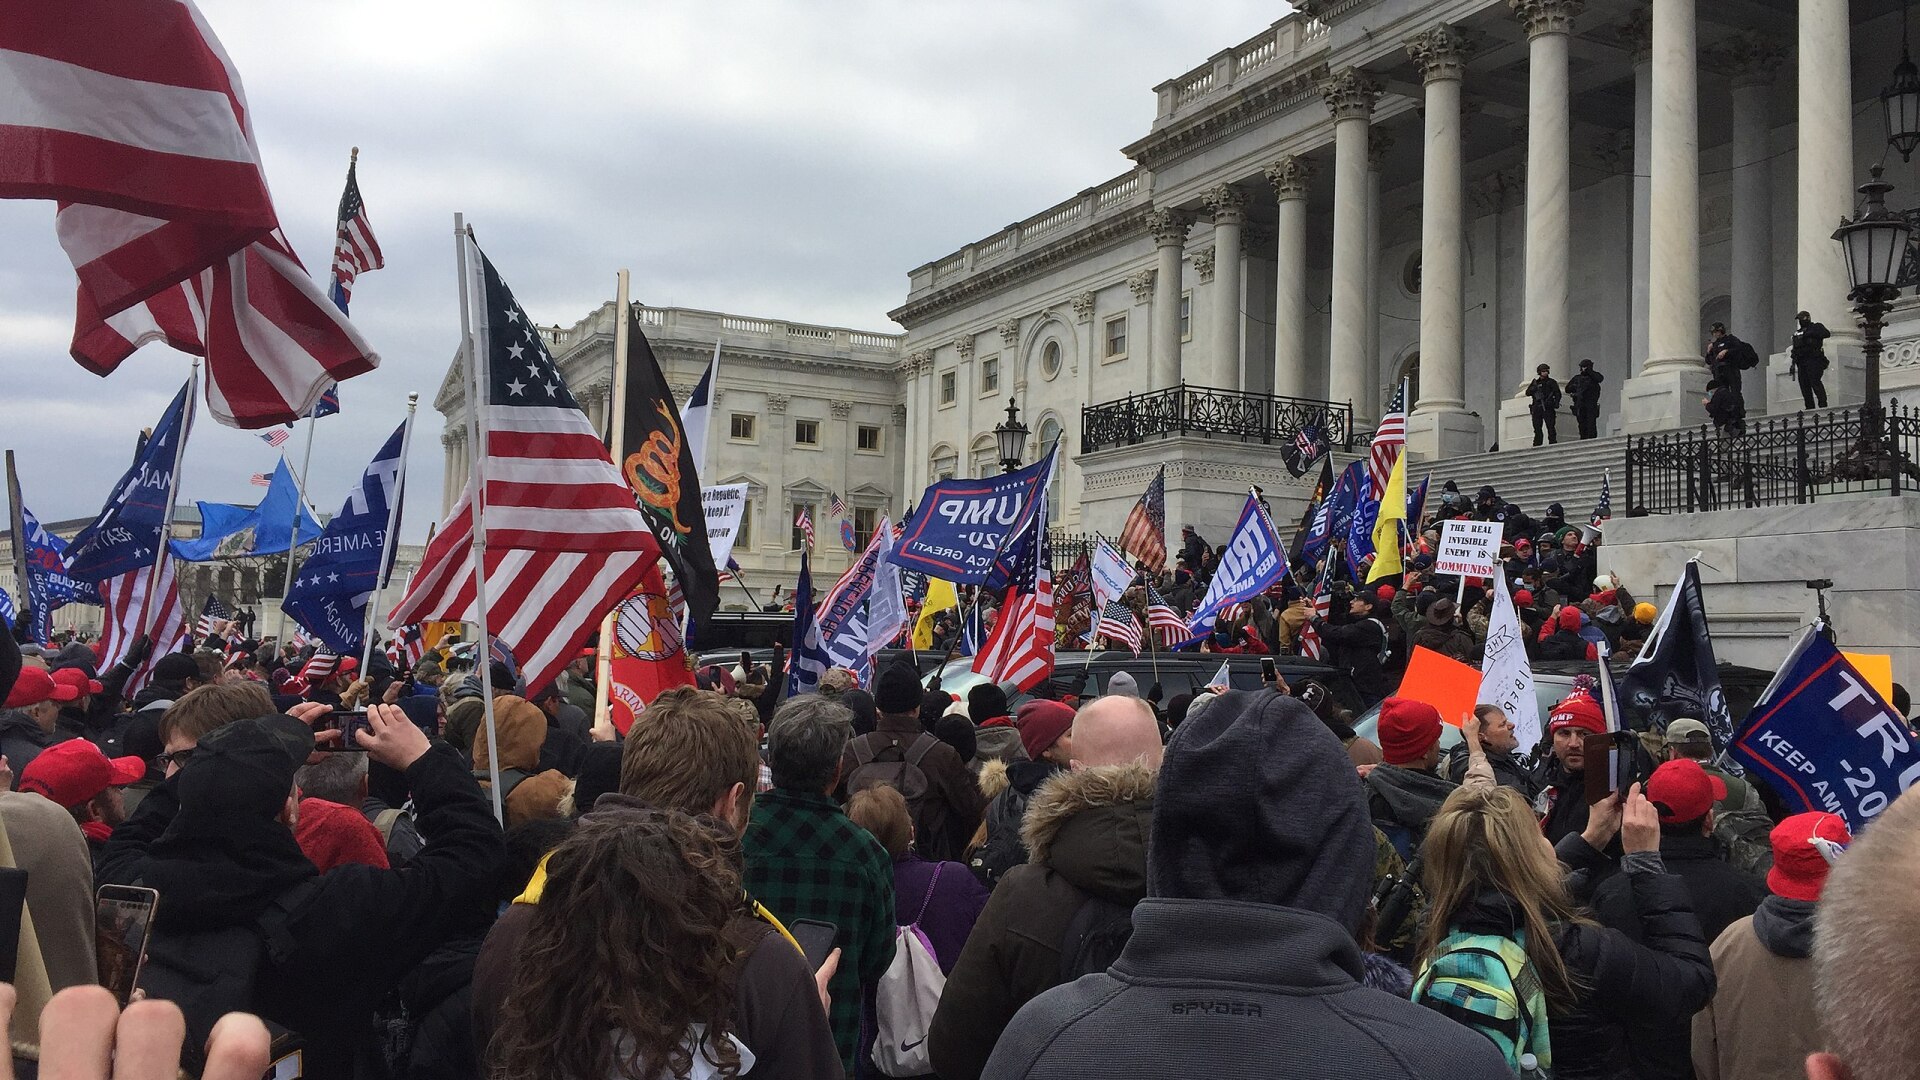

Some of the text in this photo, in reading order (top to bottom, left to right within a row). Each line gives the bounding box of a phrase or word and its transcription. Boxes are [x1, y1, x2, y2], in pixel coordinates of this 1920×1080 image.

[1450, 524, 1493, 535] THE REAL
[1448, 536, 1489, 547] INVISIBLE
[1445, 548, 1487, 559] ENEMY IS
[324, 600, 359, 648] AGAIN!
[1758, 730, 1817, 776] KEEP
[1171, 1000, 1262, 1018] SPYDER
